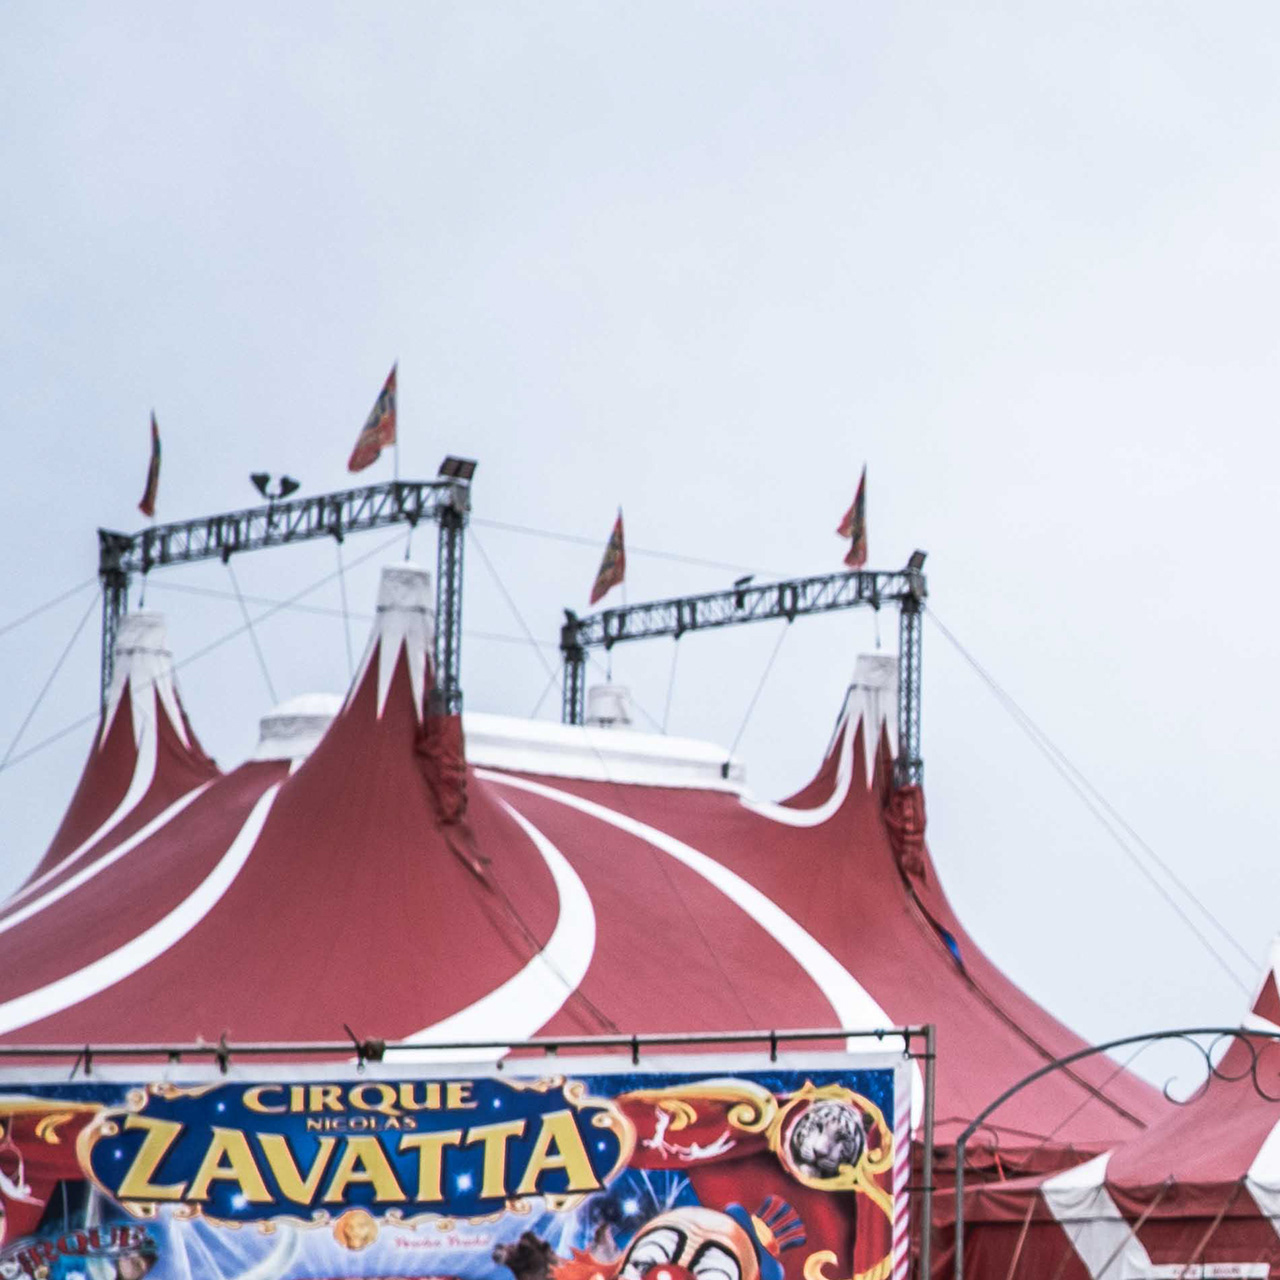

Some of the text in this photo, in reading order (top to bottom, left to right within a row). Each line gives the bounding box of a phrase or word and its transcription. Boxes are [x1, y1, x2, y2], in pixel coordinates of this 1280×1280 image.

[241, 1081, 478, 1115] CIRQUE
[306, 1116, 416, 1132] NICOLAS
[116, 1109, 604, 1205] ZAVATTA
